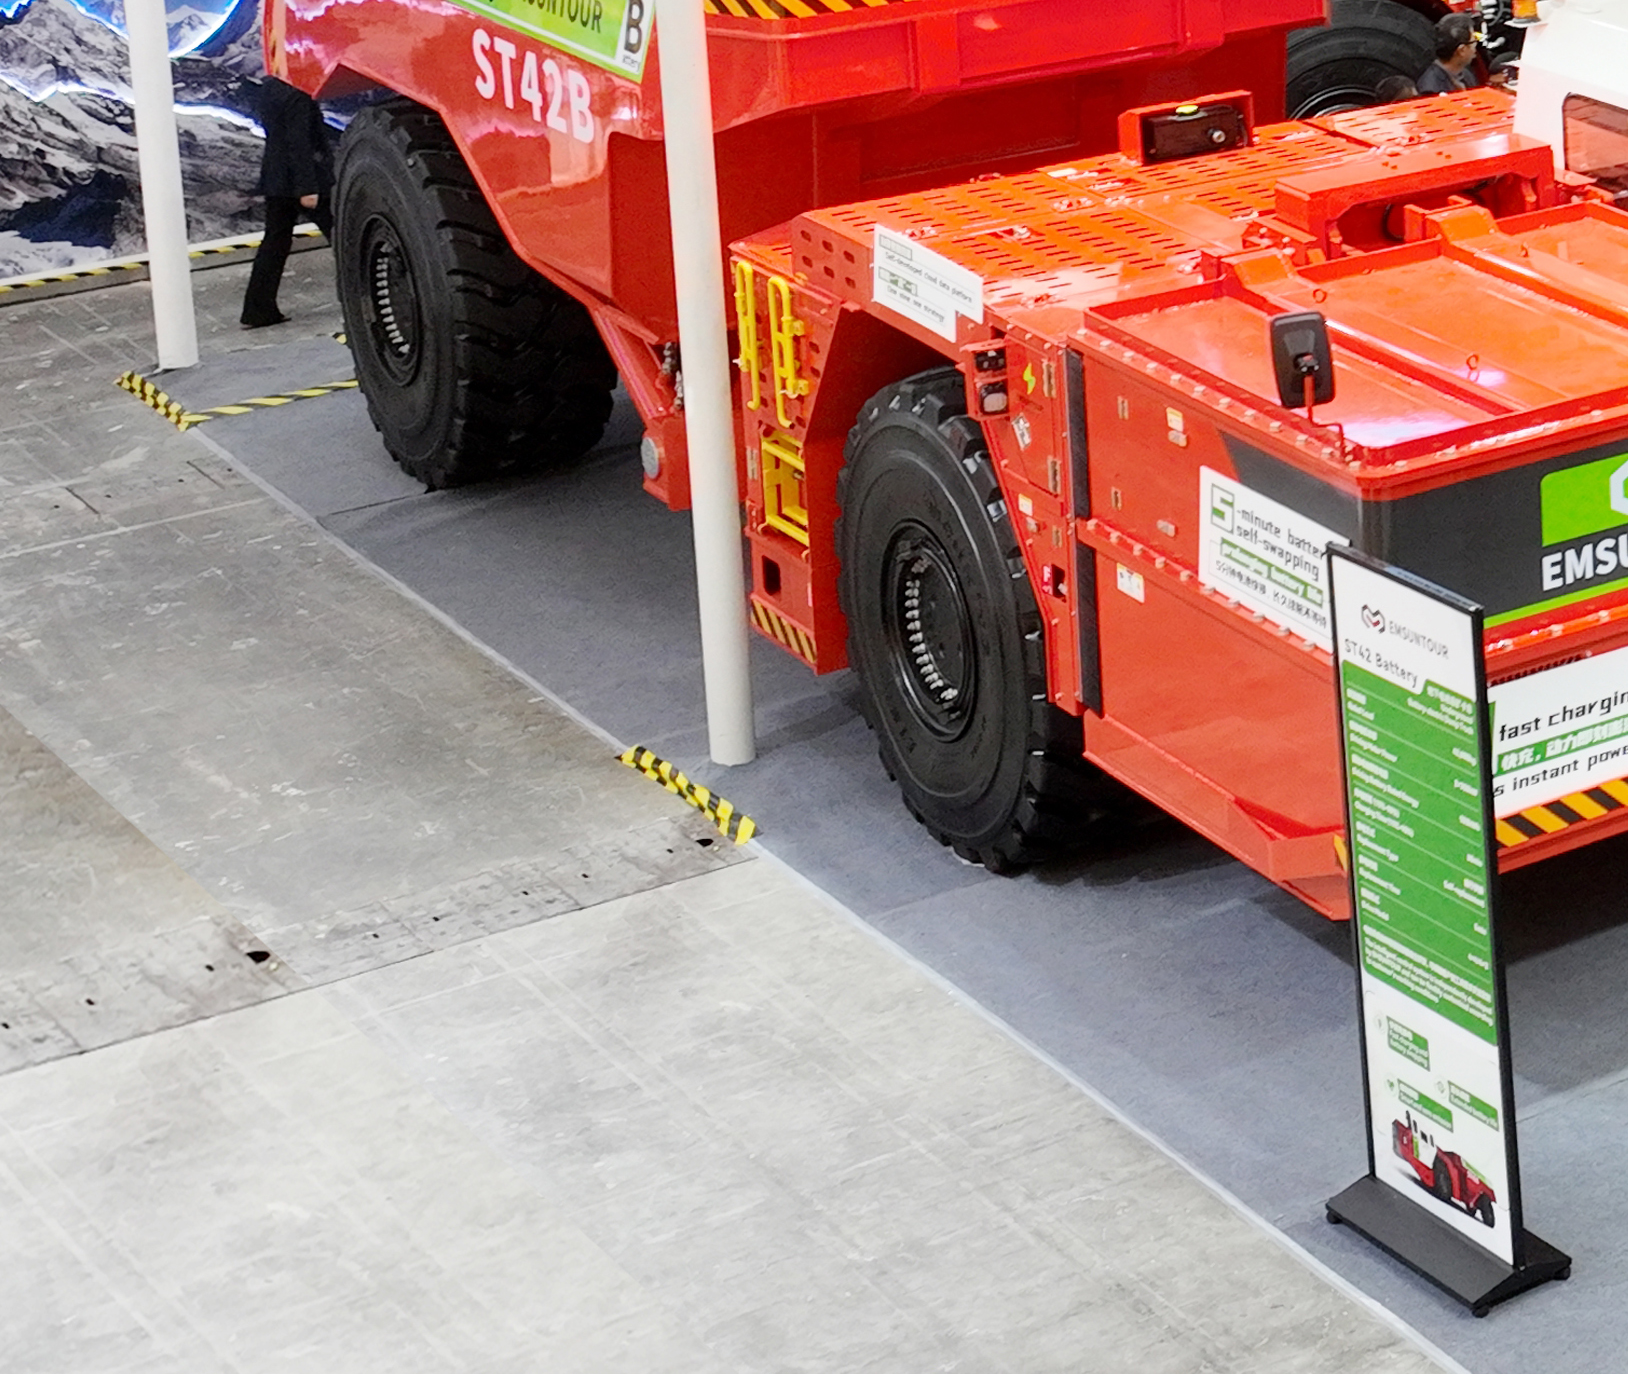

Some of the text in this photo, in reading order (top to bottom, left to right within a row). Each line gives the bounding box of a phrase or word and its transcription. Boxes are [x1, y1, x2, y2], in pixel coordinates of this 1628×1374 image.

[471, 27, 595, 144] ST42B
[1236, 524, 1321, 583] self-swapping
[1344, 637, 1419, 689] ST42 Battery
[1388, 620, 1450, 660] EMSUNTOUR
[1498, 715, 1541, 743] fast
[1512, 758, 1580, 792] instant
